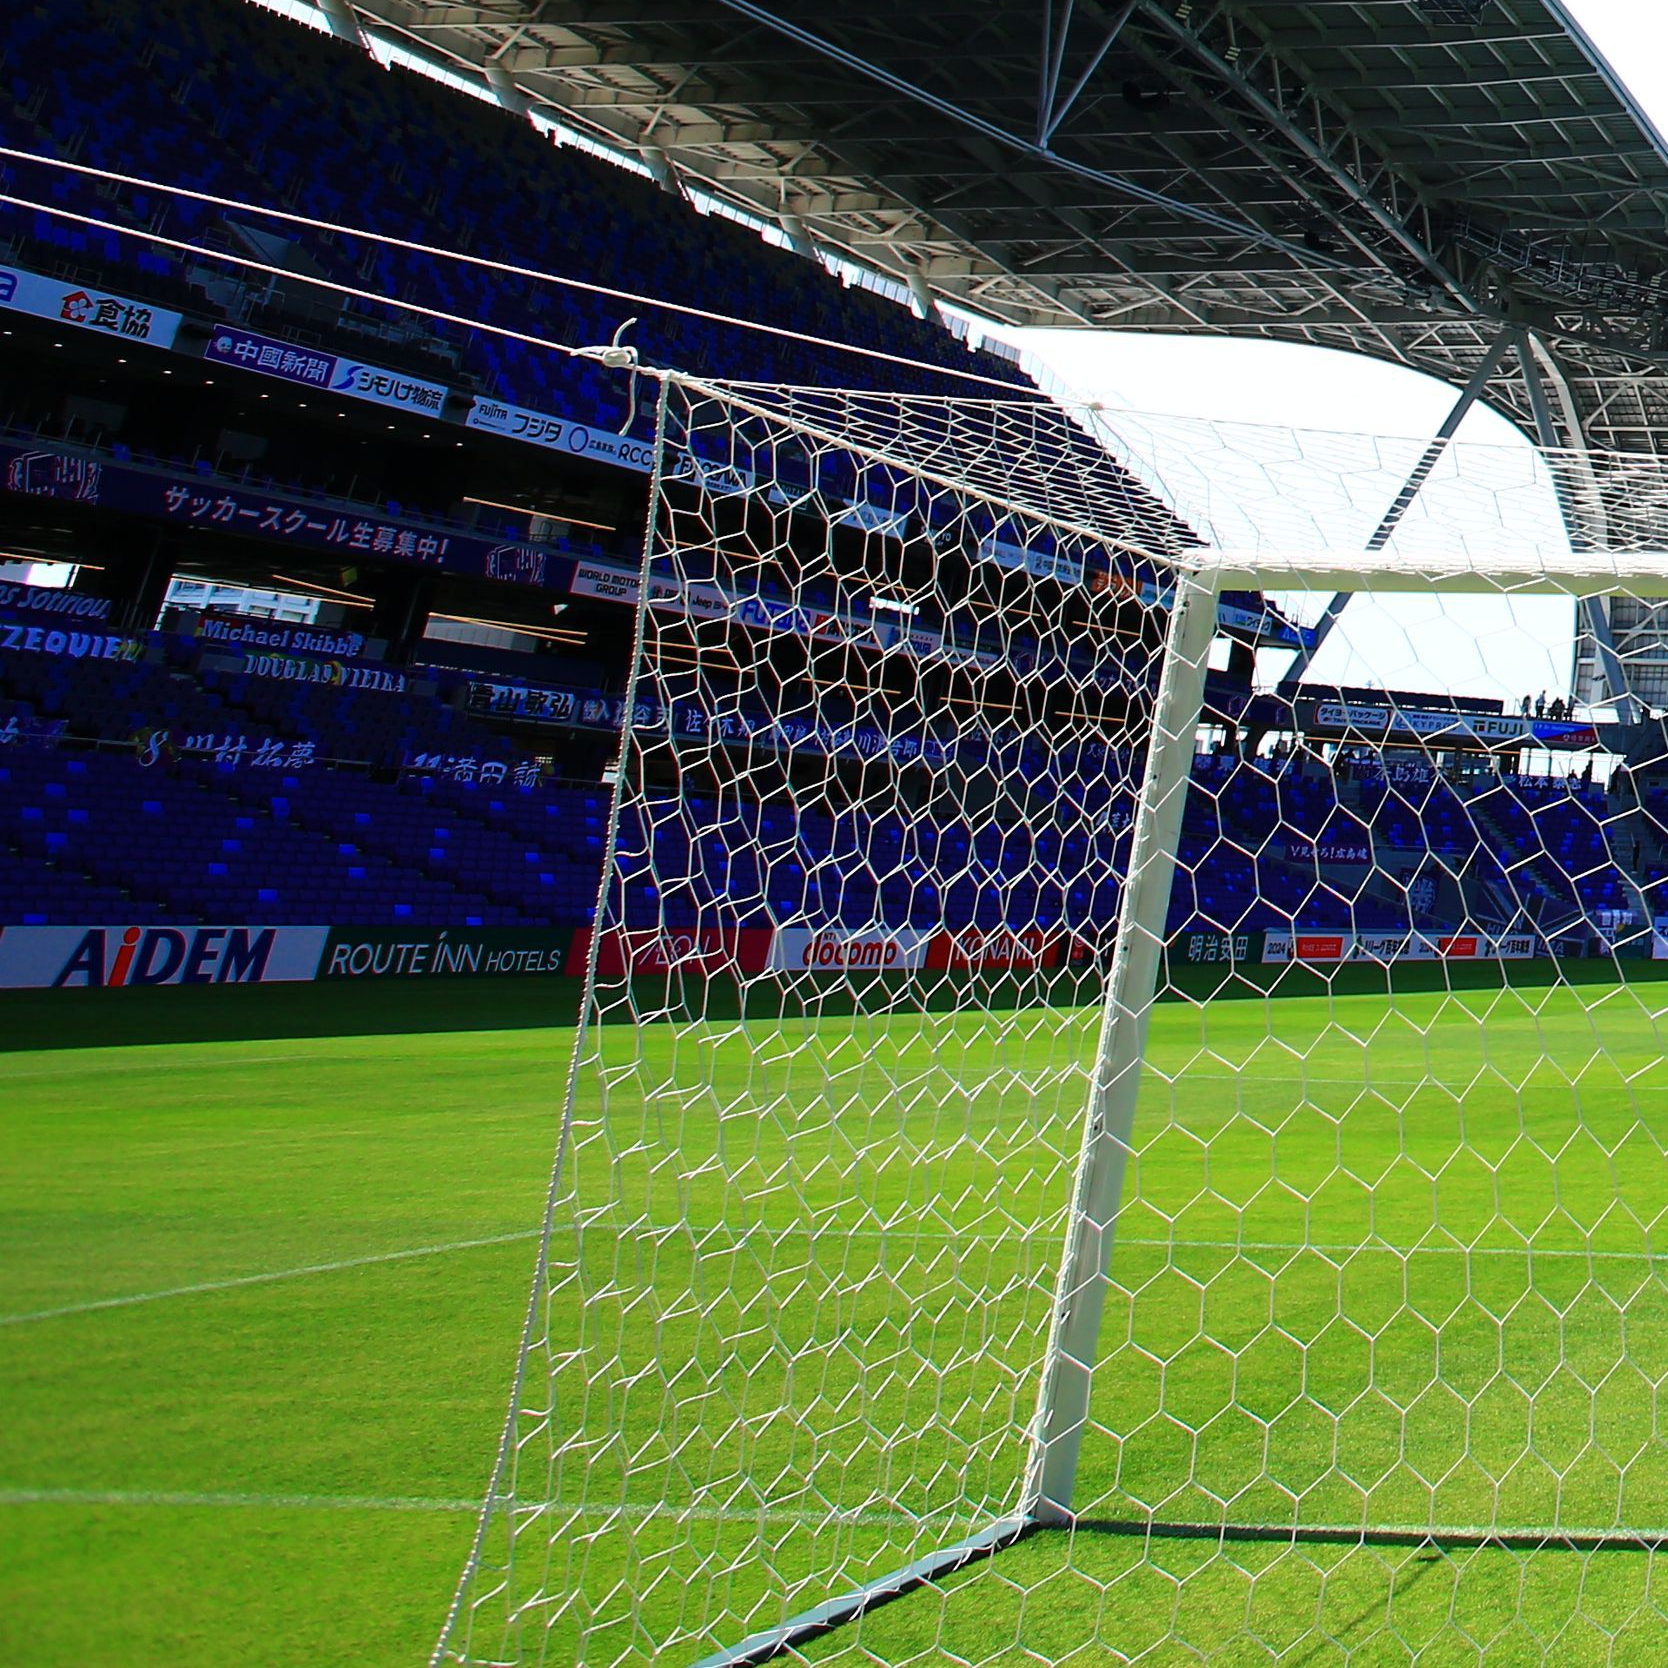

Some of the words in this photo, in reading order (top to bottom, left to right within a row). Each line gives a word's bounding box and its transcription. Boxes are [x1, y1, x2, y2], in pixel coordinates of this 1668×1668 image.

[90, 298, 152, 339] 食協
[358, 372, 444, 411] シモハナ物流
[479, 402, 508, 420] FUJITA
[512, 413, 563, 443] フジタ
[618, 443, 652, 466] RCC
[578, 568, 609, 583] WORLD
[596, 583, 627, 597] GROUP
[201, 619, 289, 648] Michael
[291, 631, 363, 658] Skibbe
[244, 653, 334, 684] DOUGLAS
[328, 939, 427, 975] ROUTE
[485, 948, 562, 972] HOTELS
[802, 936, 899, 966] docomo
[1188, 935, 1249, 962] 明治安田
